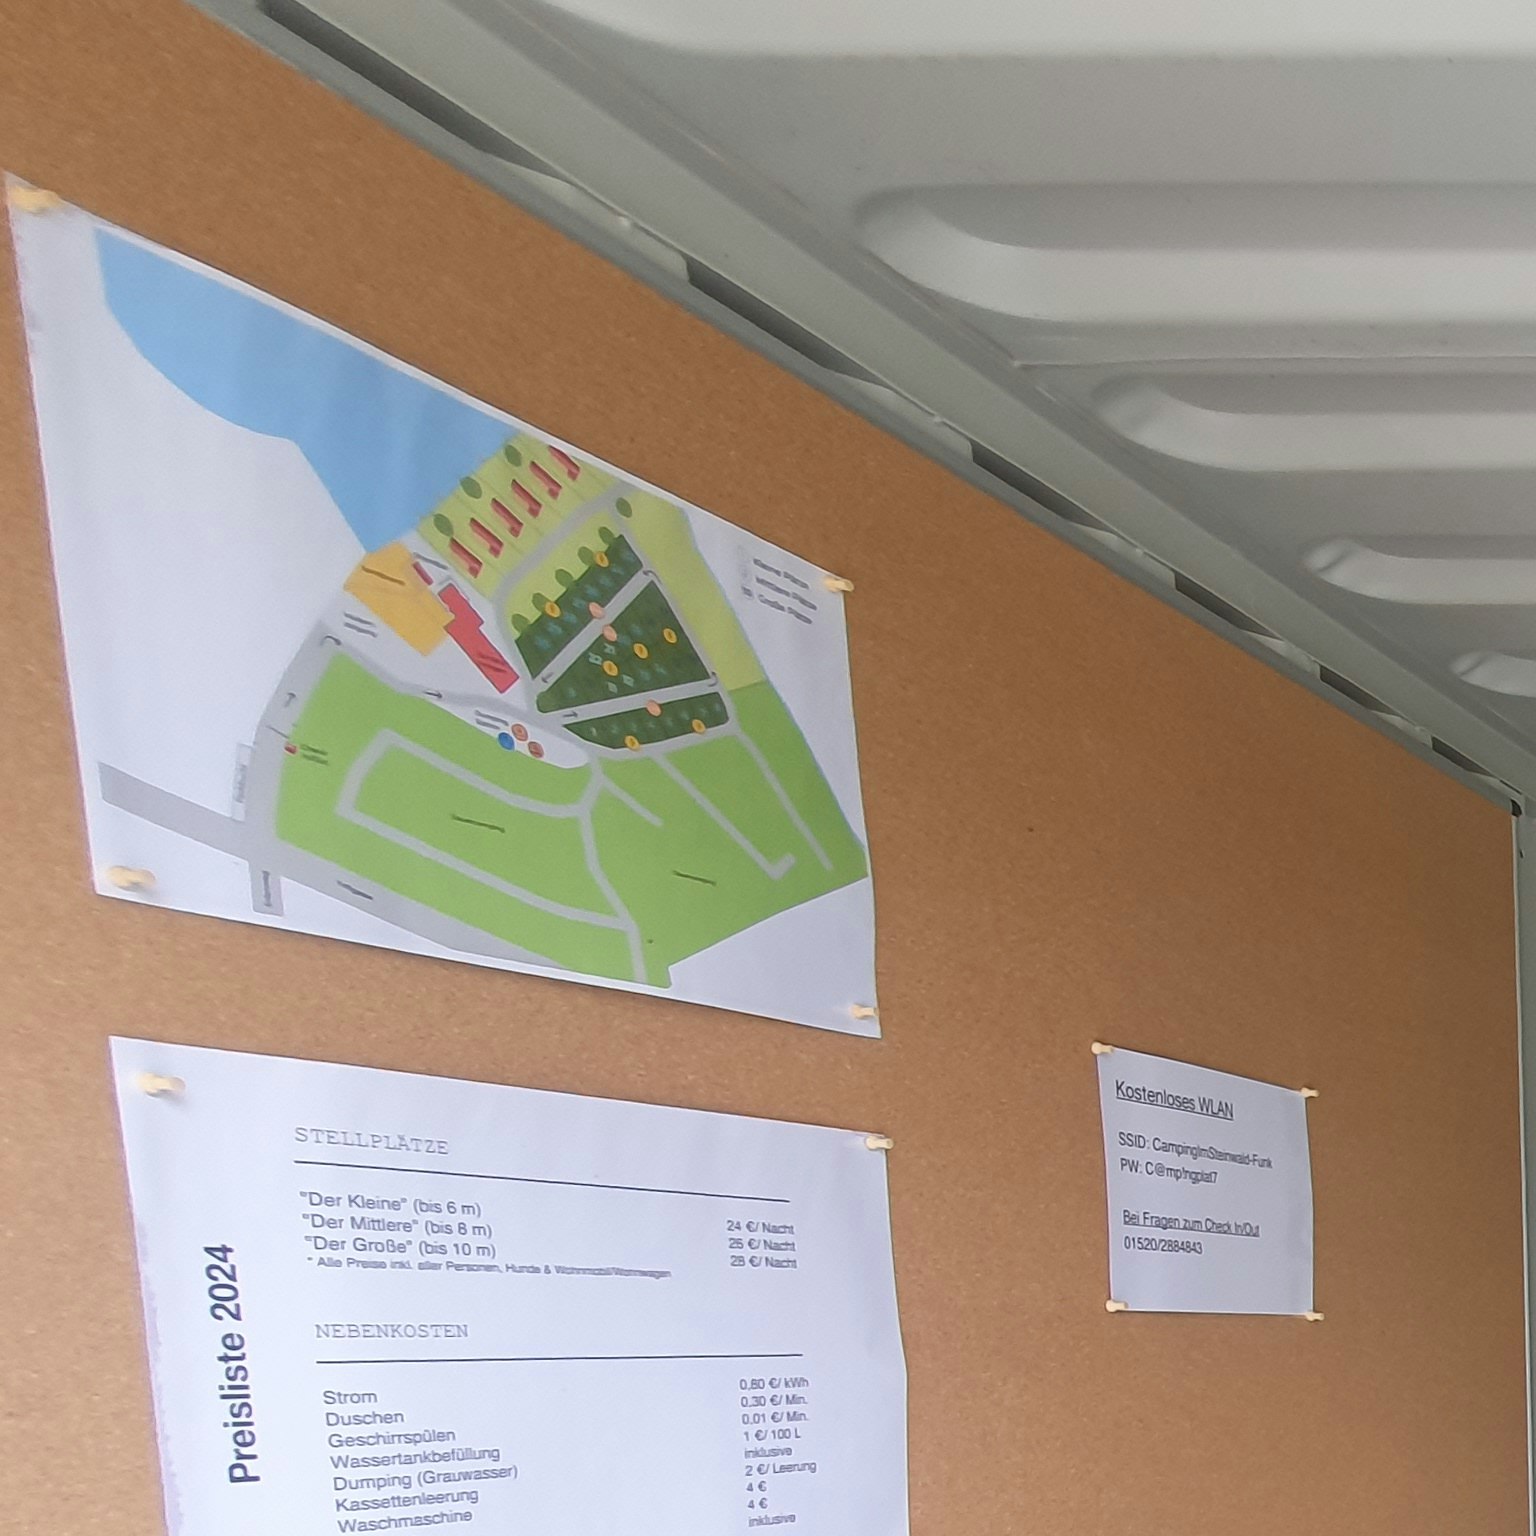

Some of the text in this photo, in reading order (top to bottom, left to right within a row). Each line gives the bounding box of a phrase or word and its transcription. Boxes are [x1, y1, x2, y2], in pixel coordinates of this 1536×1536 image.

[1115, 1079, 1234, 1118] Kostenloses WLAN
[295, 1127, 449, 1155] STELLPLÄTZE
[1118, 1131, 1150, 1150] SSID:
[1120, 1158, 1143, 1174] PW:
[300, 1191, 481, 1218] "Der Kleine" (bis 6 m)
[302, 1213, 492, 1239] "Der Mittlere" (bis 8 m)
[727, 1219, 741, 1231] 24
[1123, 1209, 1140, 1225] Bei
[1143, 1211, 1180, 1230] Fragen
[1183, 1219, 1203, 1231] zum
[304, 1236, 496, 1259] "Der Große" (bis 10 m)
[315, 1324, 469, 1338] NEBENKOSTEN
[203, 1244, 261, 1483] Preisliste 2024
[323, 1390, 378, 1405] Strom
[326, 1411, 404, 1426] Duschen
[328, 1429, 456, 1448] Geschirrspülen
[771, 1428, 791, 1439] 100
[795, 1427, 801, 1439] L
[330, 1448, 500, 1469] Wassertankbefüllung
[333, 1465, 518, 1491] Dumping (Grauwasser)
[745, 1465, 753, 1476] 2
[746, 1482, 754, 1492] 4
[335, 1490, 479, 1512] Kassettenleerung
[747, 1499, 755, 1509] 4
[338, 1510, 472, 1533] Waschmaschine
